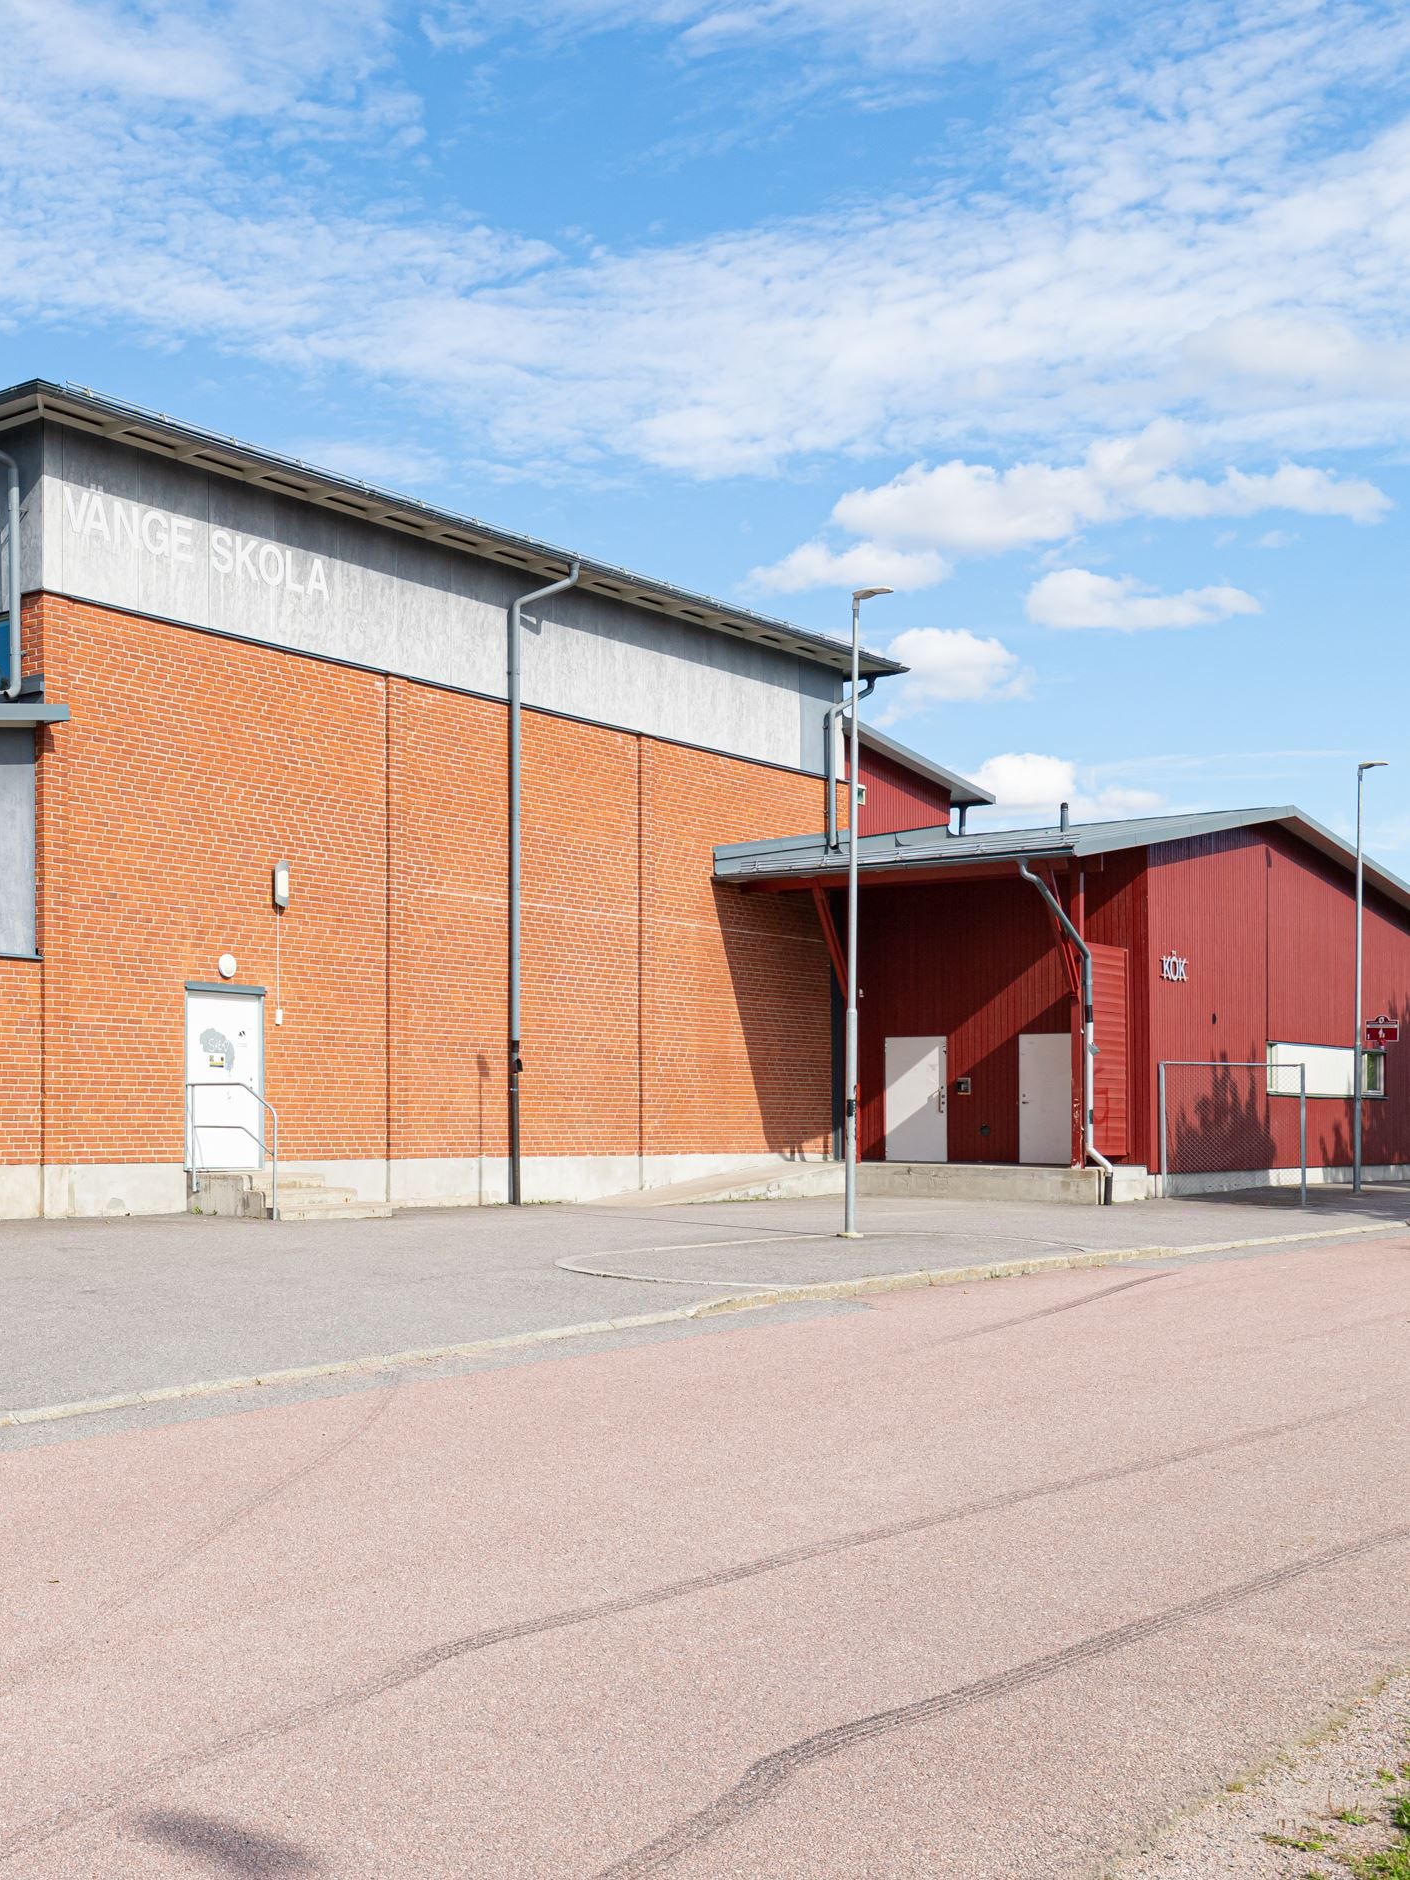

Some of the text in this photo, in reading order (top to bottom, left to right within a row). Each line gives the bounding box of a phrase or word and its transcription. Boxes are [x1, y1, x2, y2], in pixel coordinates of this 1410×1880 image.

[63, 484, 331, 600] VÄNGE SKOLA
[1163, 950, 1187, 982] KÖK
